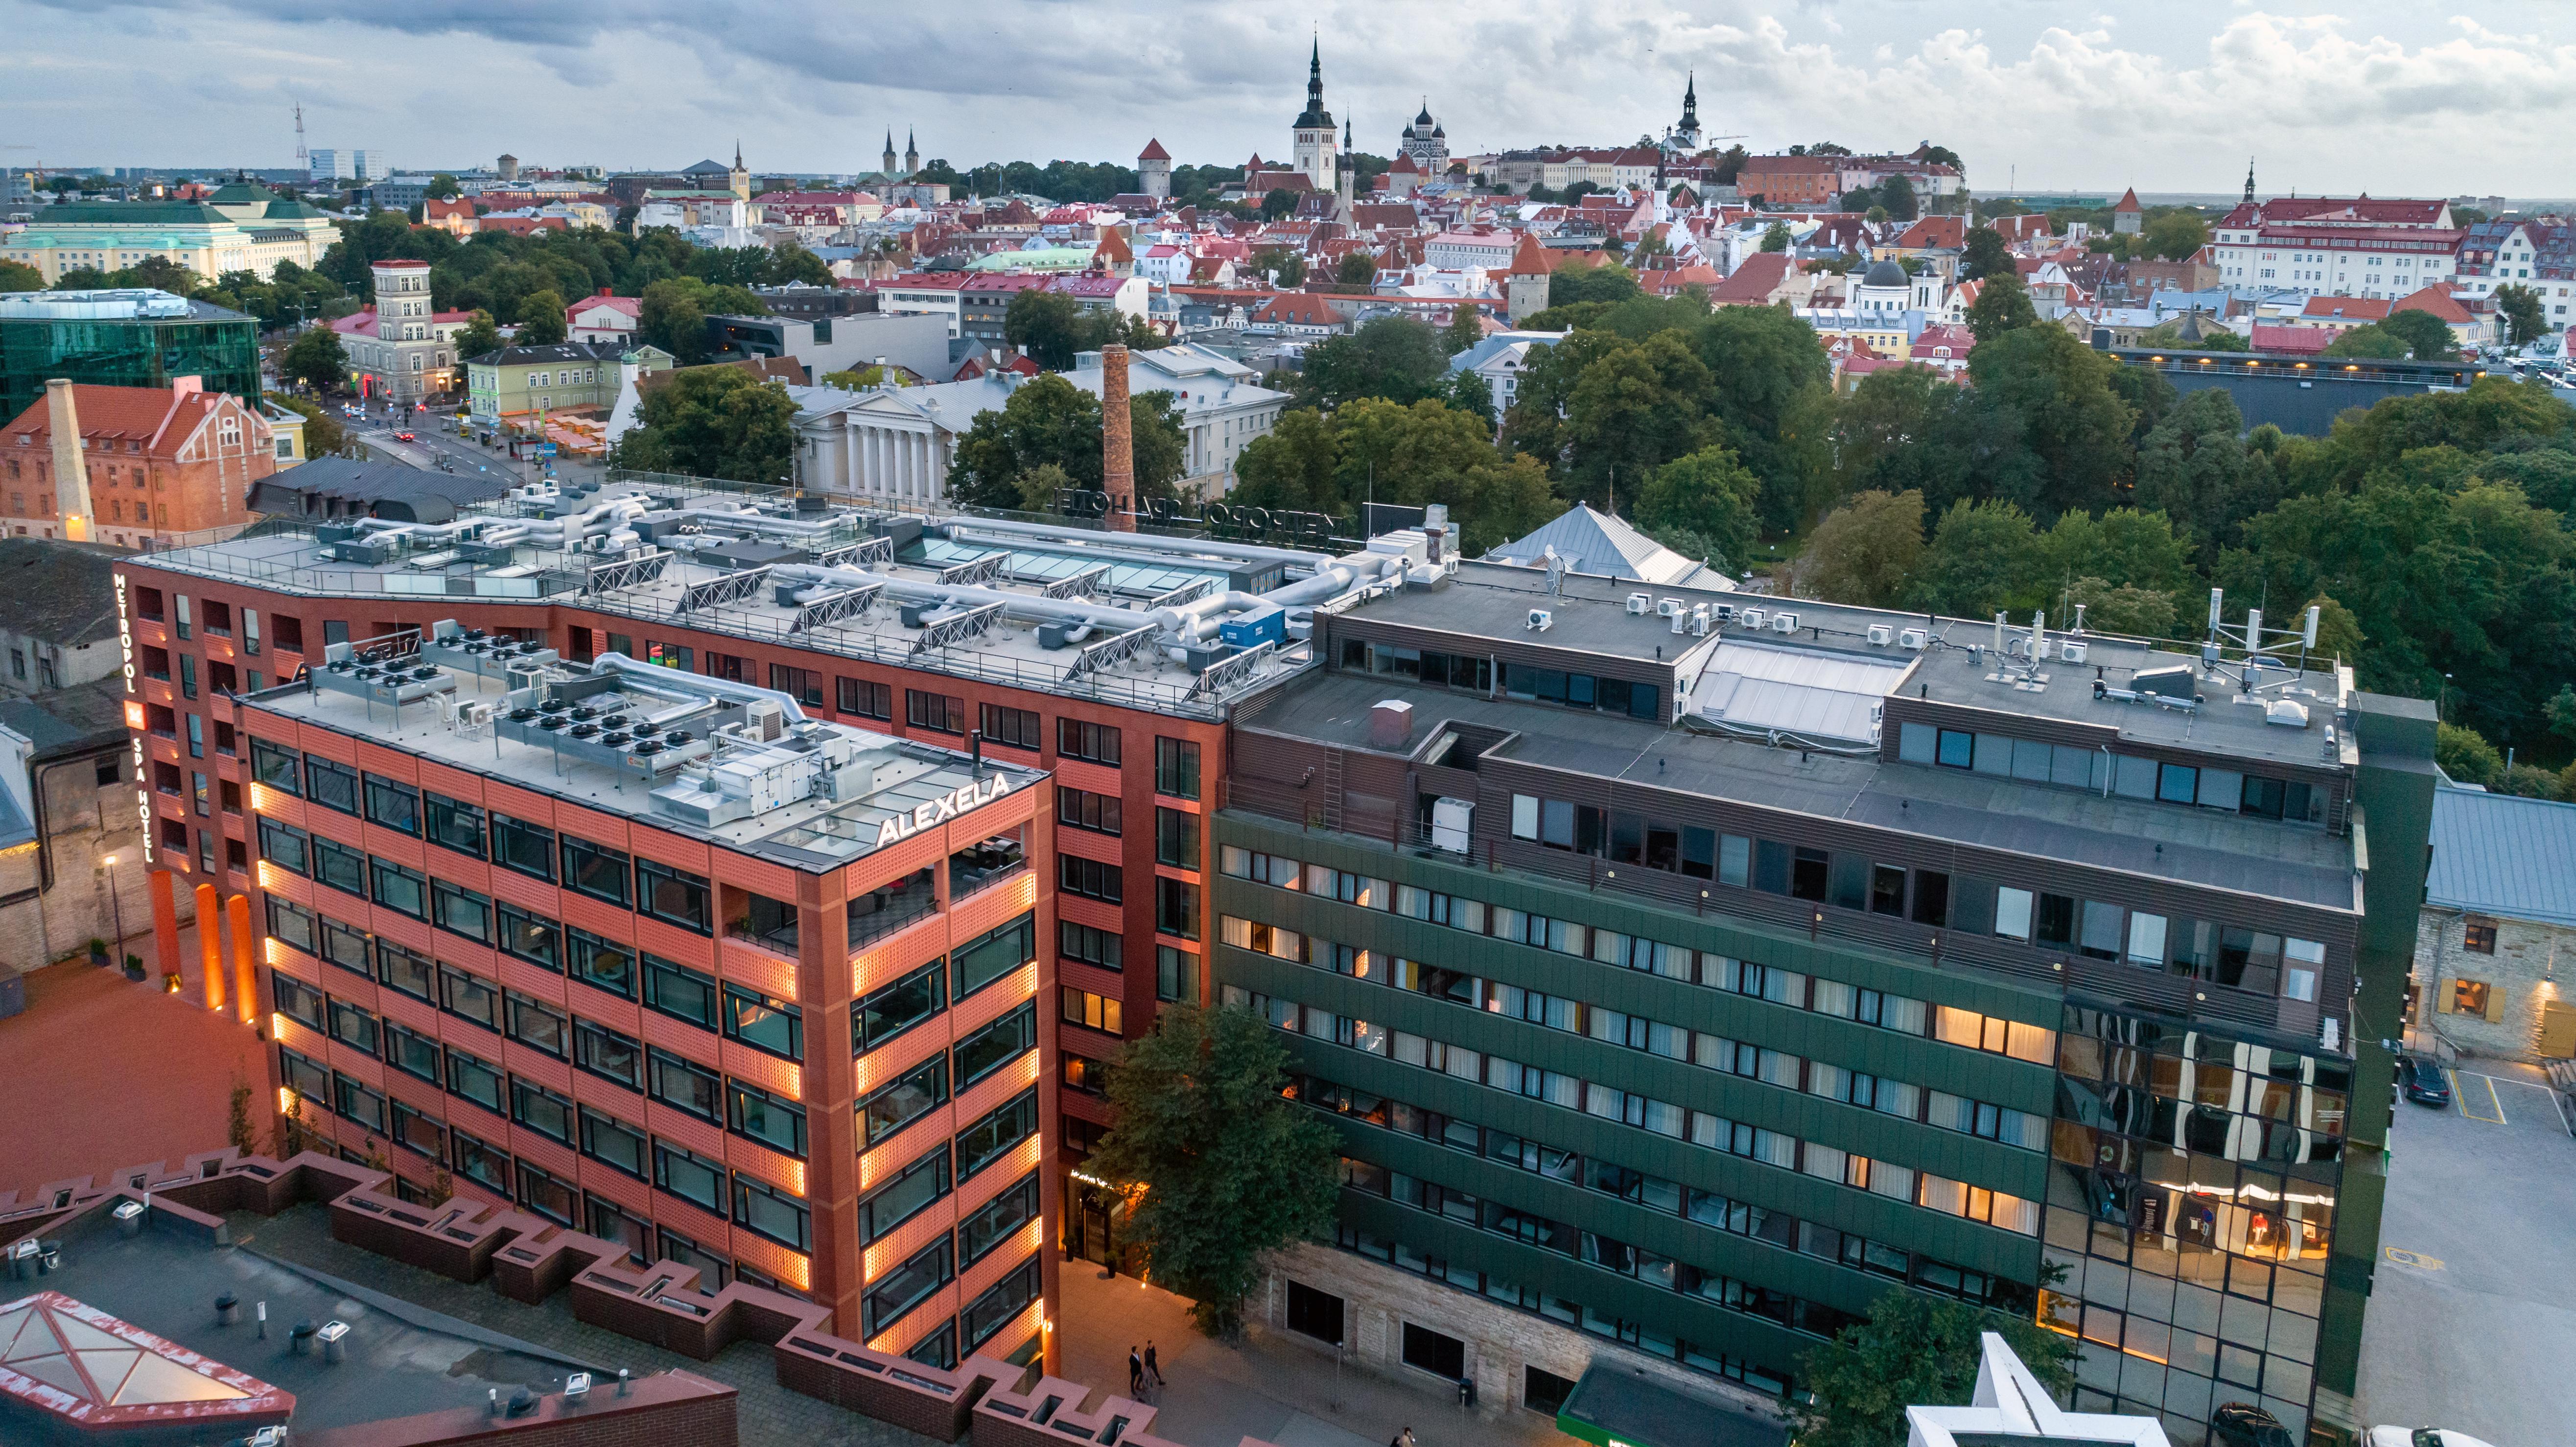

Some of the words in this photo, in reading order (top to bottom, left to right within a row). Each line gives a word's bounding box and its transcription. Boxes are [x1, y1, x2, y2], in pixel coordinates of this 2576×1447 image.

[114, 574, 135, 693] METROPOL
[133, 738, 145, 782] SPA
[139, 790, 154, 863] HOTEL
[876, 772, 1009, 847] ALEXELA
